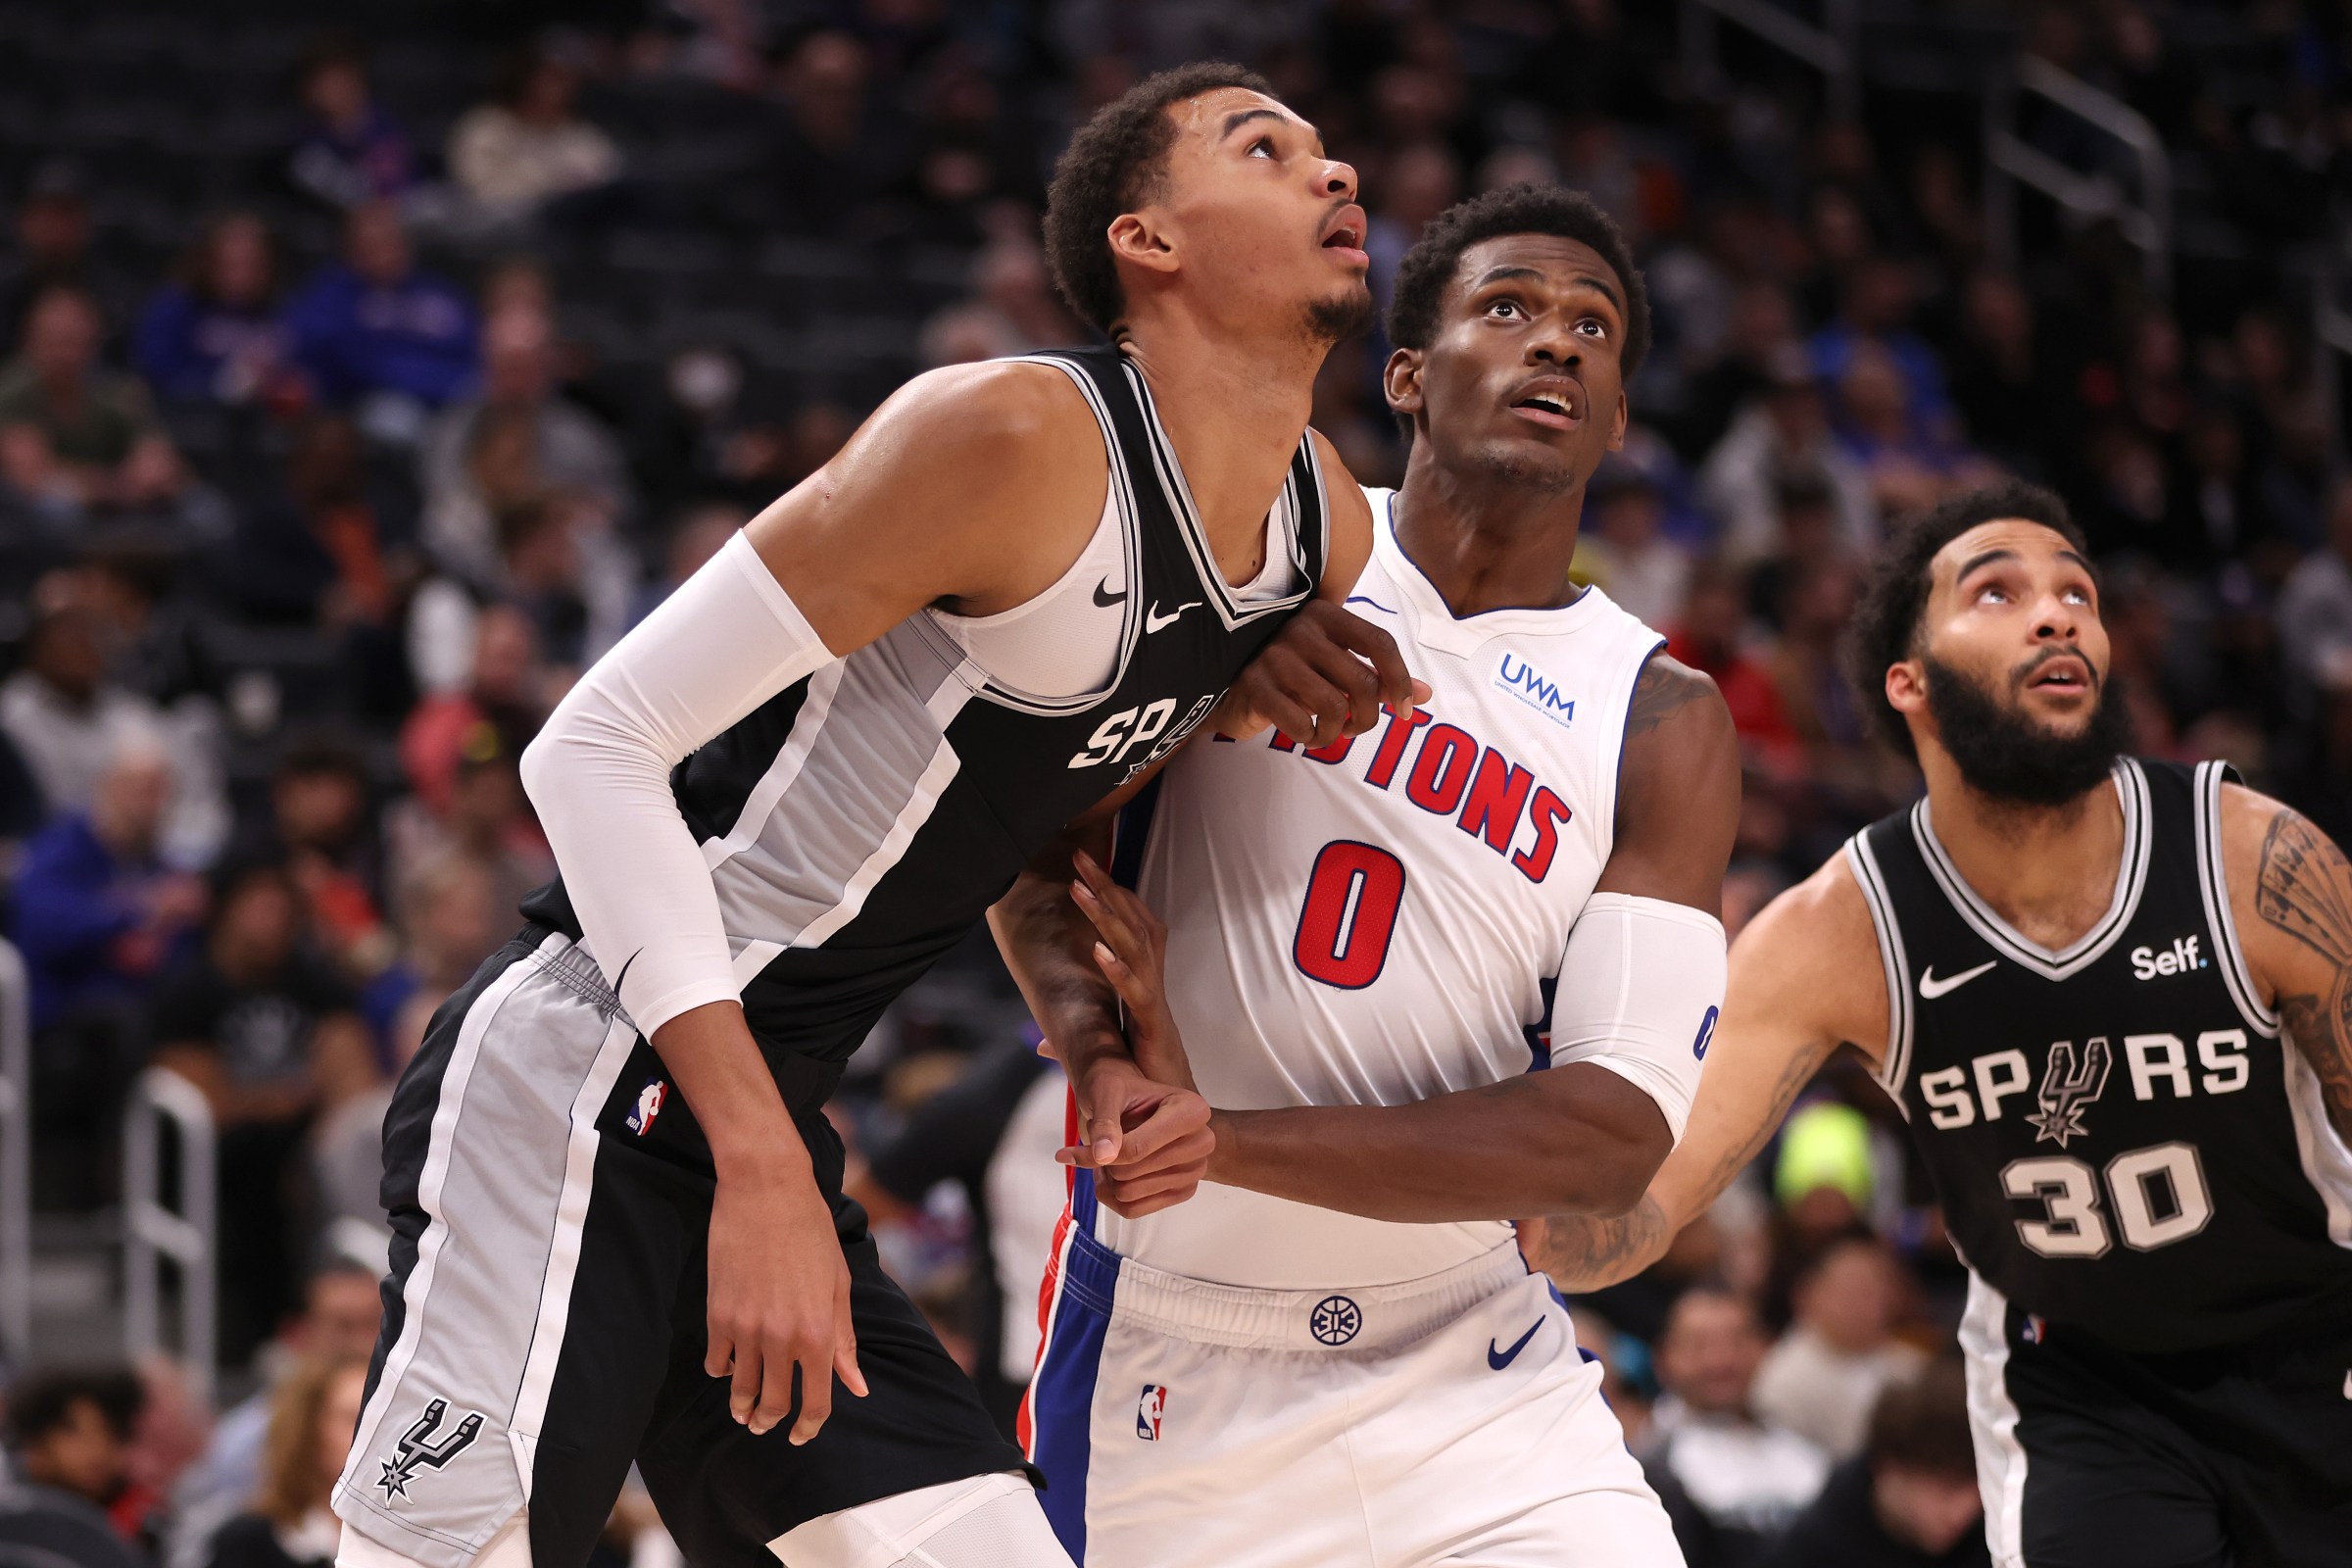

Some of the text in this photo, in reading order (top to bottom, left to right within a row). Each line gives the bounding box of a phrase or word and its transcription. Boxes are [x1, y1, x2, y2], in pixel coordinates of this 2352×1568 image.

[1494, 680, 1512, 694] UNITED
[1500, 653, 1575, 721] UWM
[1212, 702, 1572, 884] TONS
[1292, 839, 1406, 991] 0
[2131, 933, 2208, 981] Self.
[1919, 1027, 2250, 1150] SPURS
[625, 1115, 641, 1131] NBA
[1998, 1140, 2215, 1260] 30
[1313, 1304, 1359, 1338] 313
